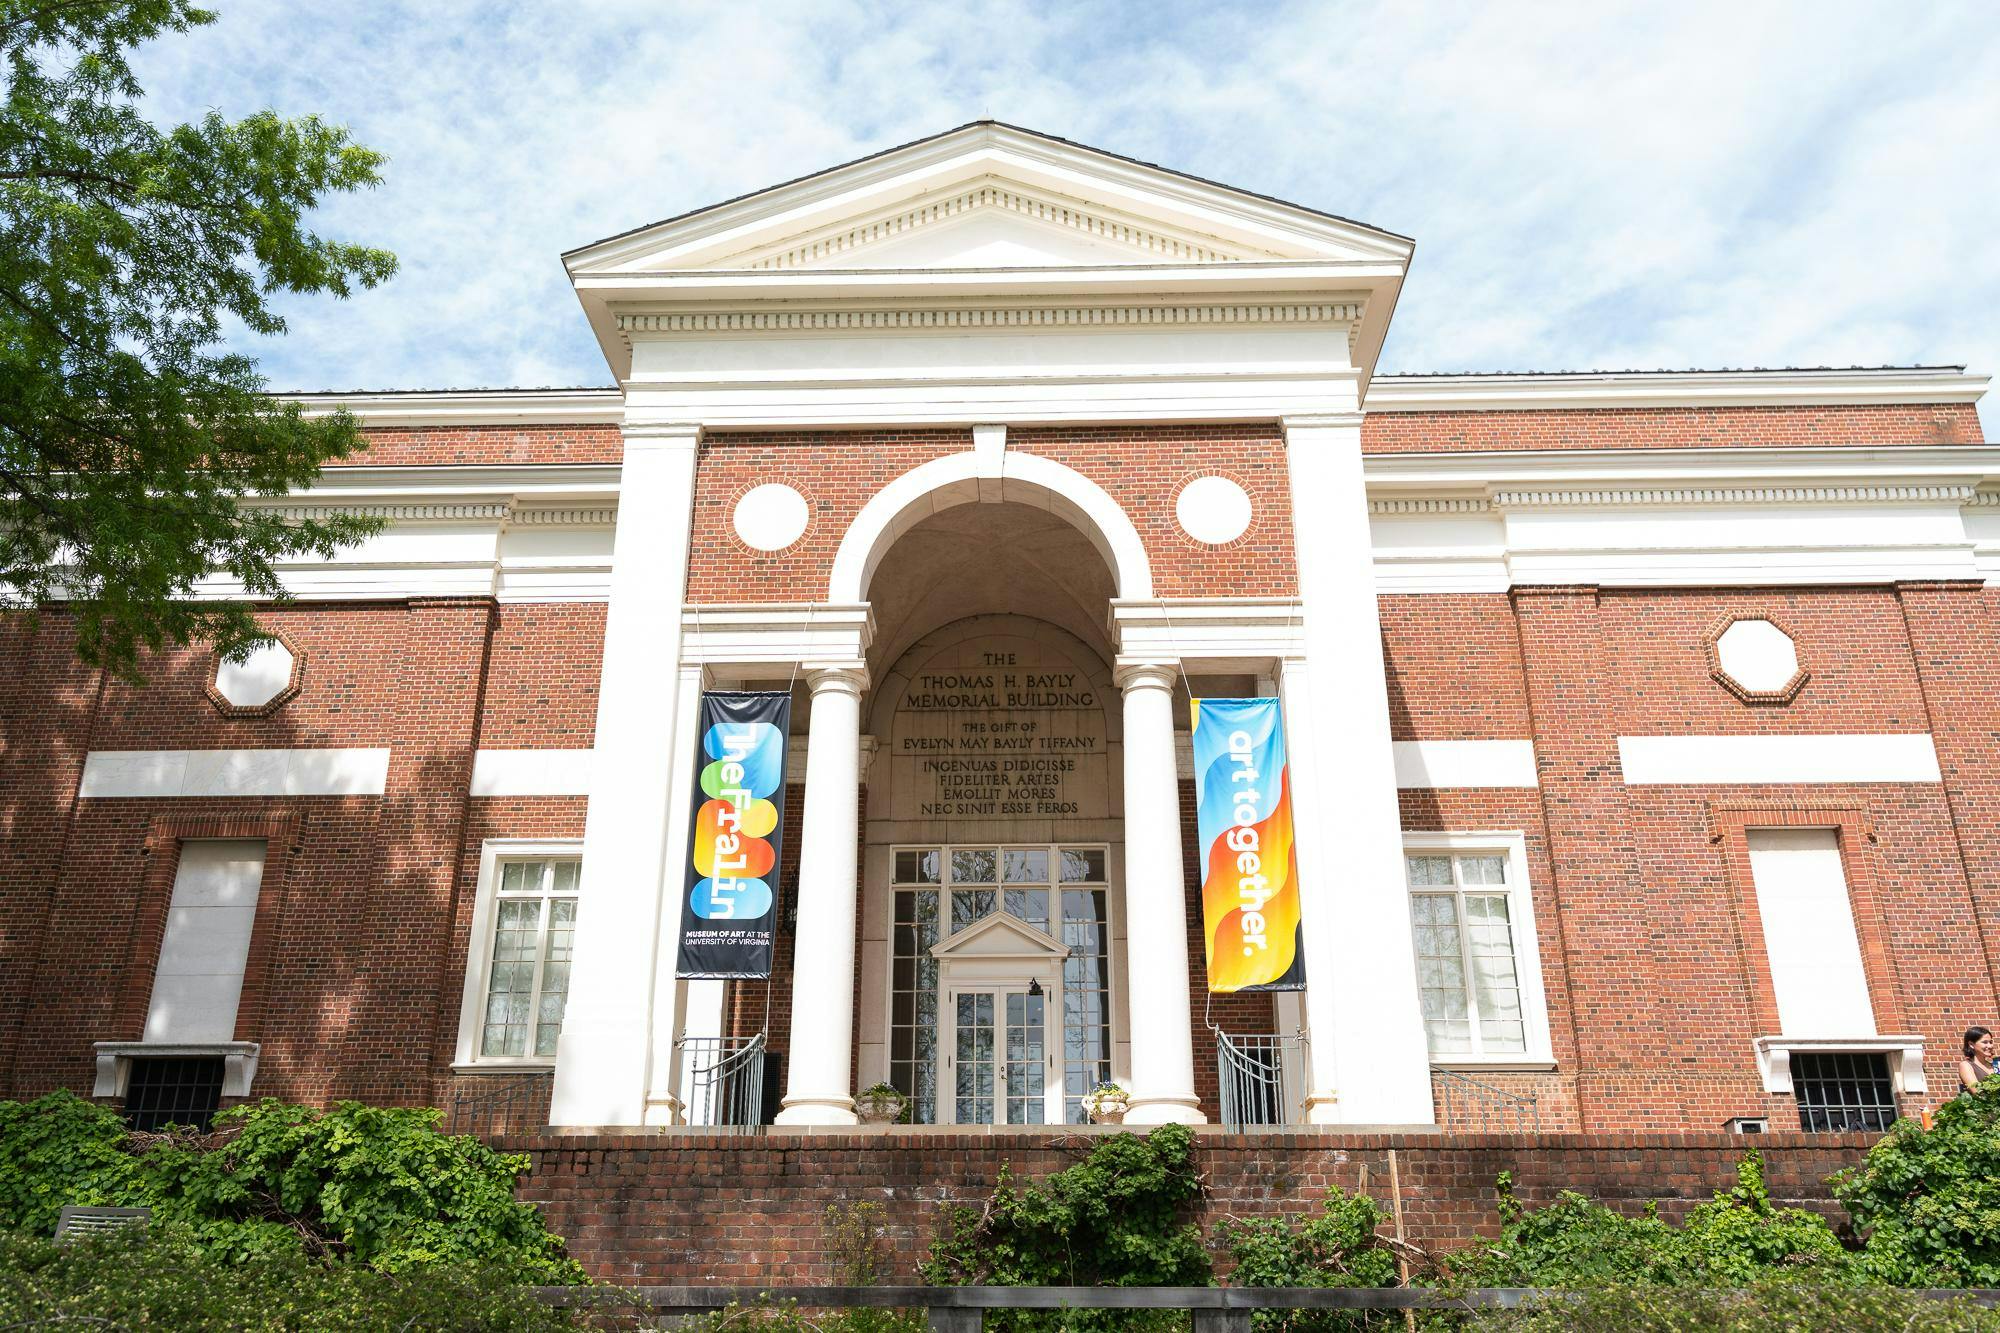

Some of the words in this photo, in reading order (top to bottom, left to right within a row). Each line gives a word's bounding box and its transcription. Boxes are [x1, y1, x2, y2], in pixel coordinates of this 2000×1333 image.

[984, 653, 1016, 665] THE
[920, 675, 994, 688] THOMAS
[1005, 675, 1020, 688] H.
[1027, 674, 1075, 688] BAYLY
[907, 694, 1000, 707] MEMORIAL
[1007, 693, 1093, 706] BUILDING
[962, 723, 985, 732] THE
[990, 723, 1017, 732] GIFT
[1021, 722, 1036, 732] OF
[904, 738, 954, 749] EVELYN
[960, 738, 989, 749] MAY
[994, 737, 1034, 748] BAYLY
[1039, 737, 1096, 748] TIFFANY
[1228, 731, 1260, 783] art
[924, 761, 997, 772] INGENUAS
[1004, 760, 1075, 771] DIDICISSE
[940, 775, 1011, 785] FIDELITER
[1016, 774, 1059, 785] ARTES
[944, 789, 1001, 800] EMOLLIT
[1008, 788, 1055, 799] MORES
[921, 803, 952, 814] NEC
[957, 803, 996, 814] SINIT
[1001, 803, 1032, 813] ESSE
[1037, 802, 1078, 813] FEROS
[1227, 788, 1271, 956] together.
